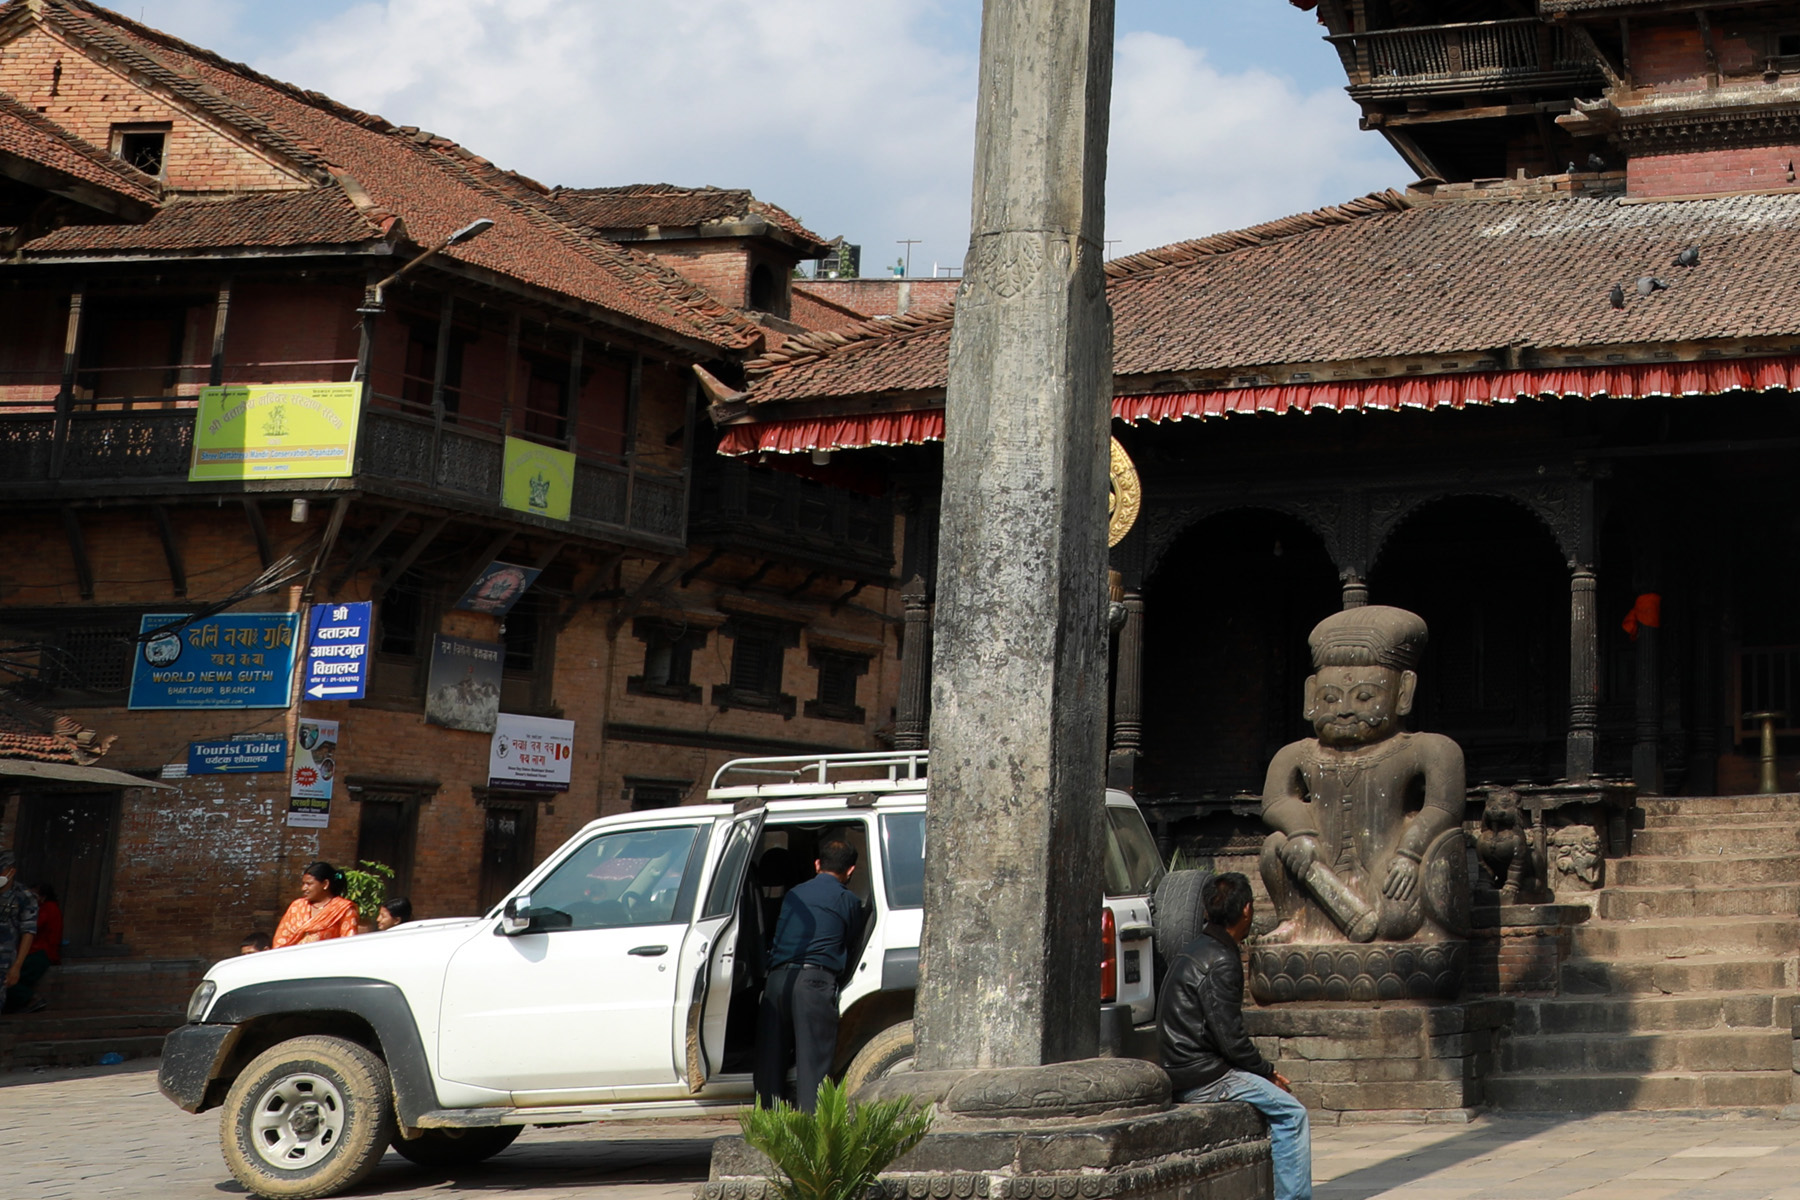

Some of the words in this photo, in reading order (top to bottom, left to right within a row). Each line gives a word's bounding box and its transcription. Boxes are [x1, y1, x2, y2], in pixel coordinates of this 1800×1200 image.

[251, 449, 269, 459] Mandir
[271, 448, 307, 459] Conservation
[309, 447, 344, 459] Organization
[332, 605, 349, 622] श्री
[310, 644, 366, 659] आधारभूत
[313, 660, 360, 676] विद्यालय
[152, 670, 196, 683] WORLD
[200, 670, 234, 682] NEWA
[238, 670, 274, 682] GUTHI
[168, 686, 214, 695] BHAKTAPUR
[220, 686, 256, 695] BRANCH
[195, 744, 240, 756] Tourist
[244, 742, 281, 754] Toilet
